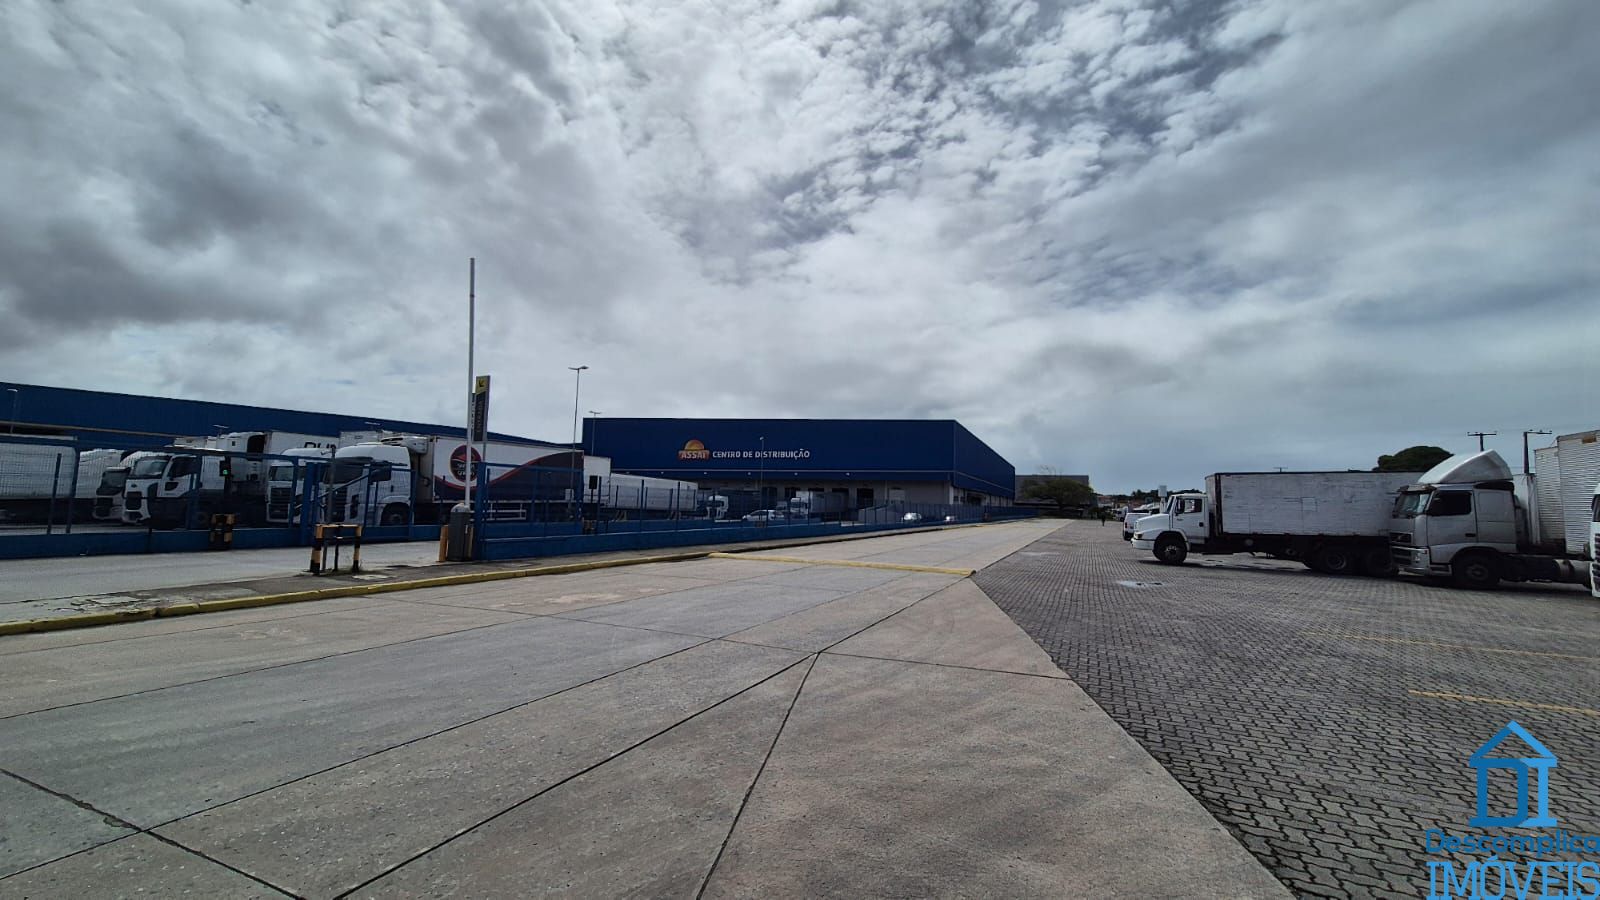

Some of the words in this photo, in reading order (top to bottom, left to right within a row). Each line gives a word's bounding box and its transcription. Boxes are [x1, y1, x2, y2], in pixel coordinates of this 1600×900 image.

[712, 450, 741, 458] CENTRO
[742, 450, 753, 458] DE
[754, 448, 810, 460] DISTRIBUIÇÃO
